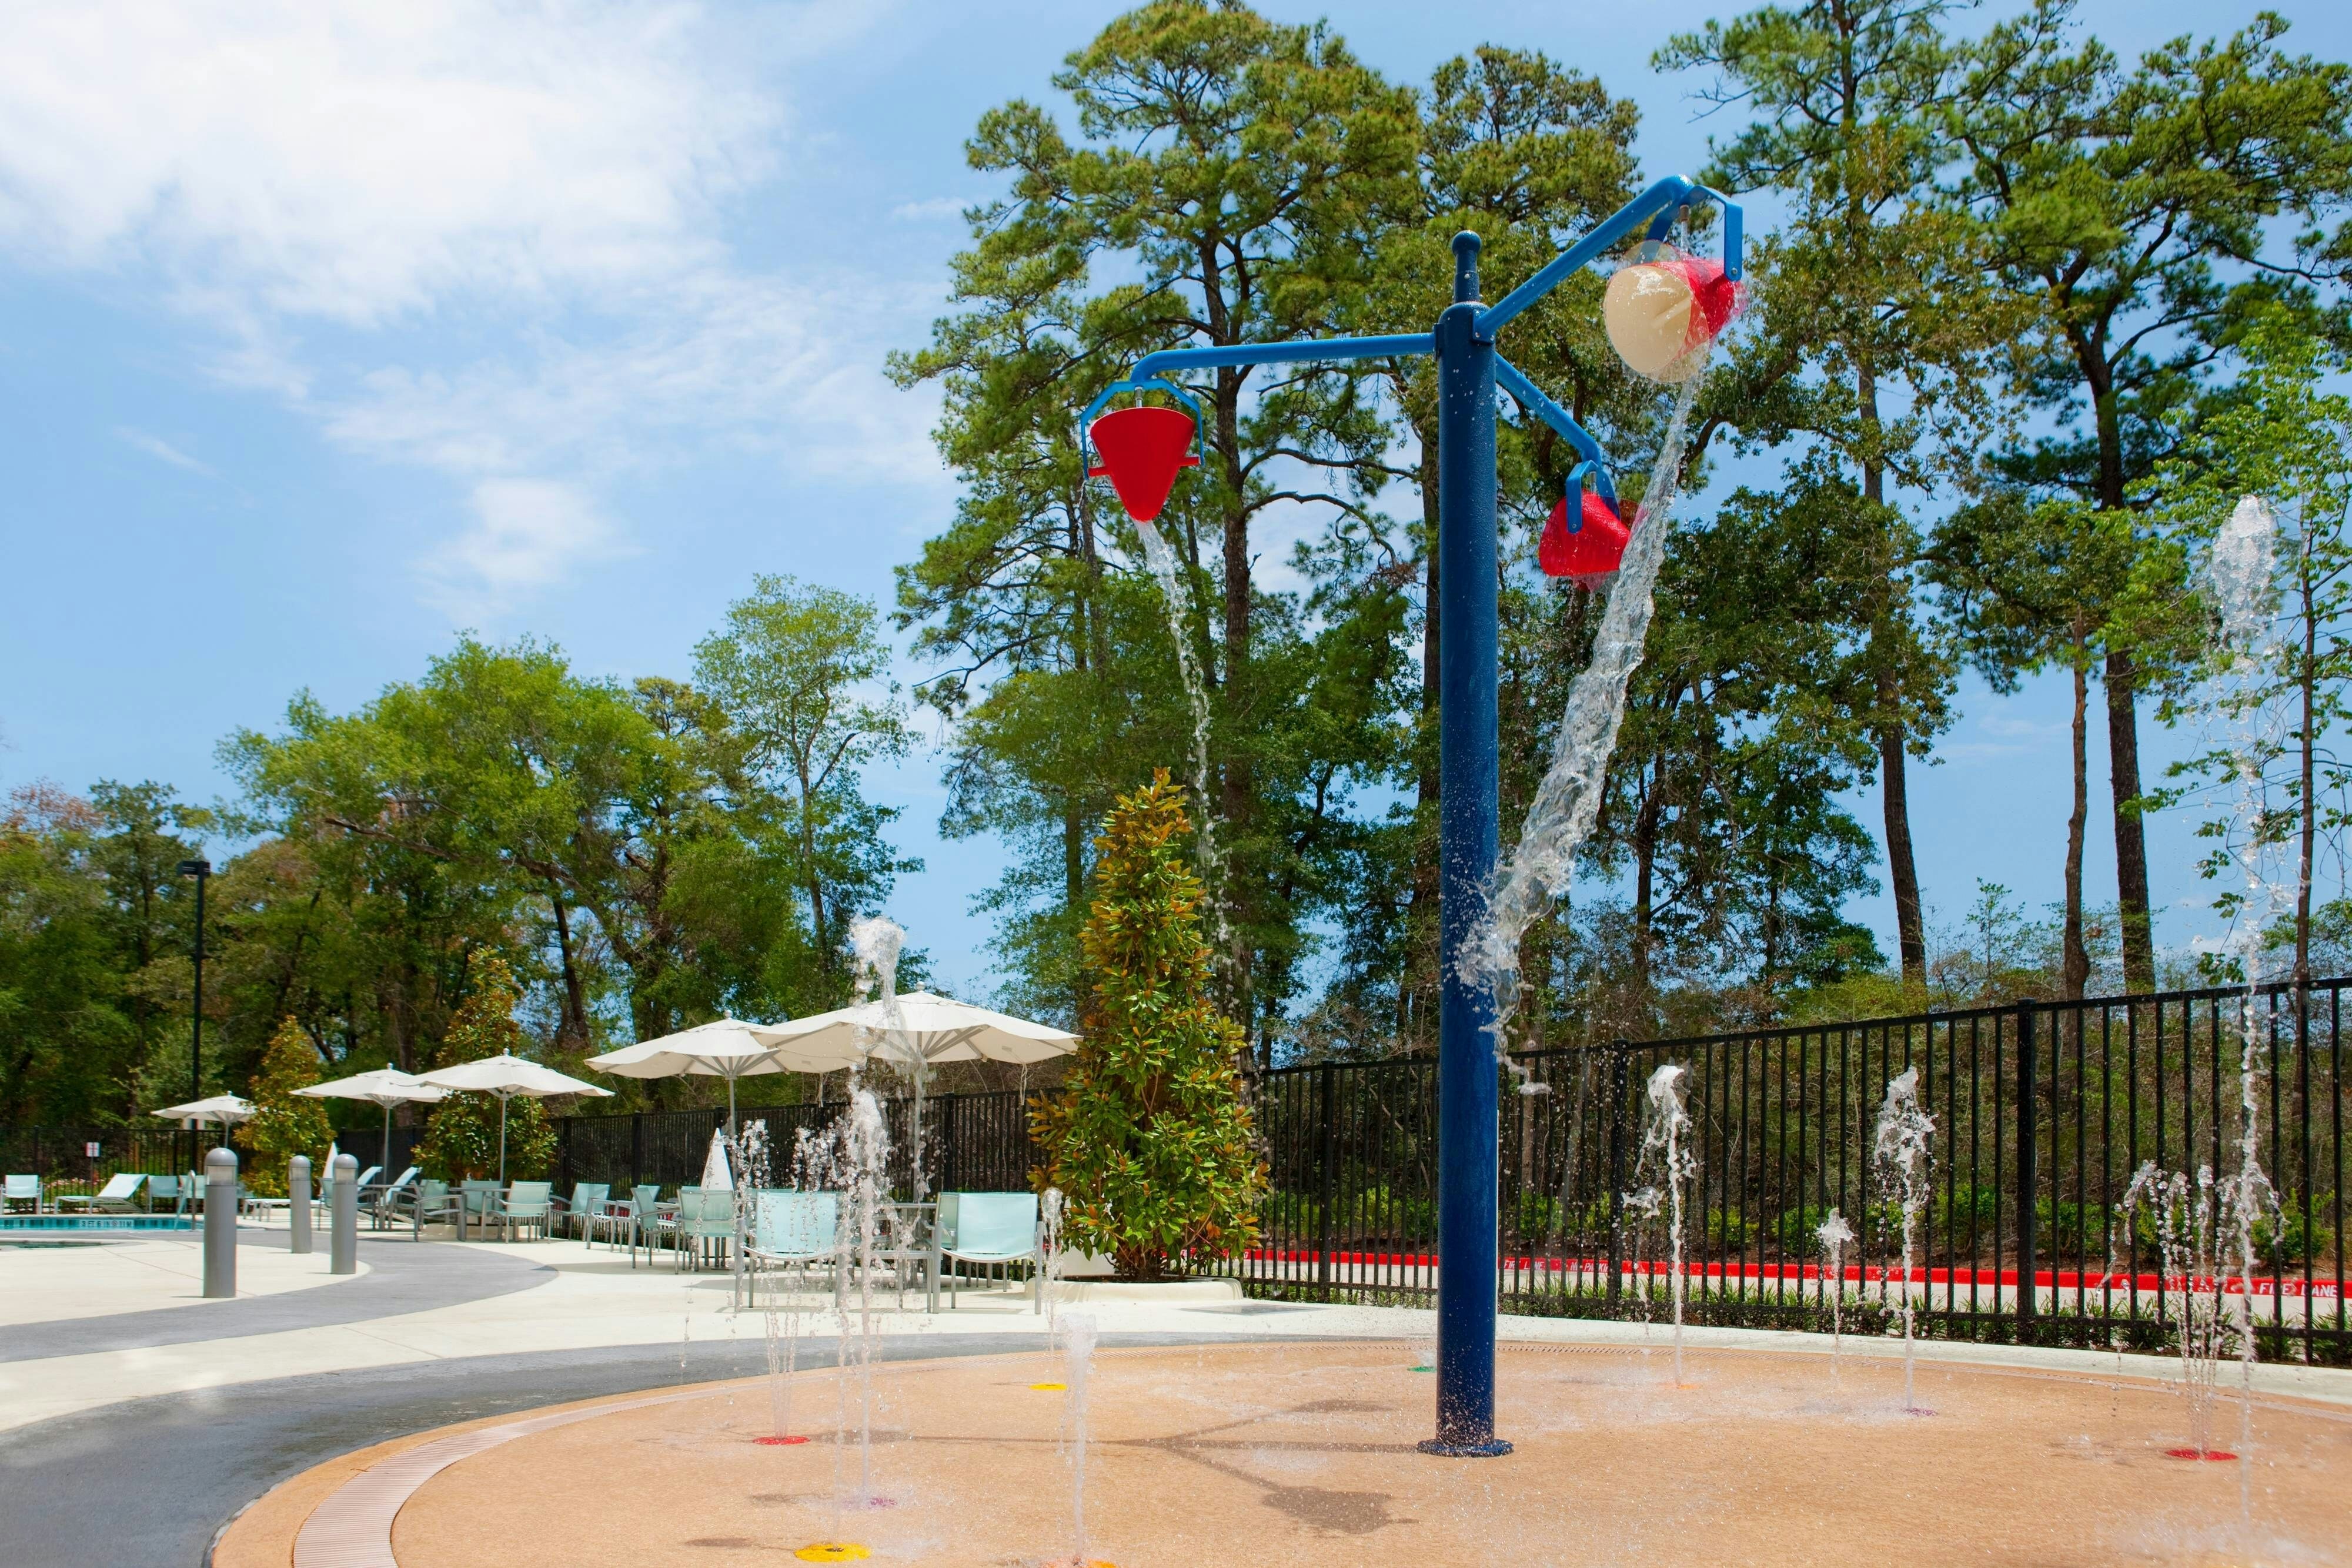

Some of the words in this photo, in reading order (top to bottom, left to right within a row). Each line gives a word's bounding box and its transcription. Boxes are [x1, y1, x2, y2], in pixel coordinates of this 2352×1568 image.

[1504, 1259, 1521, 1269] FIR
[1524, 1261, 1544, 1270] LNE
[2259, 1282, 2291, 1295] FIE
